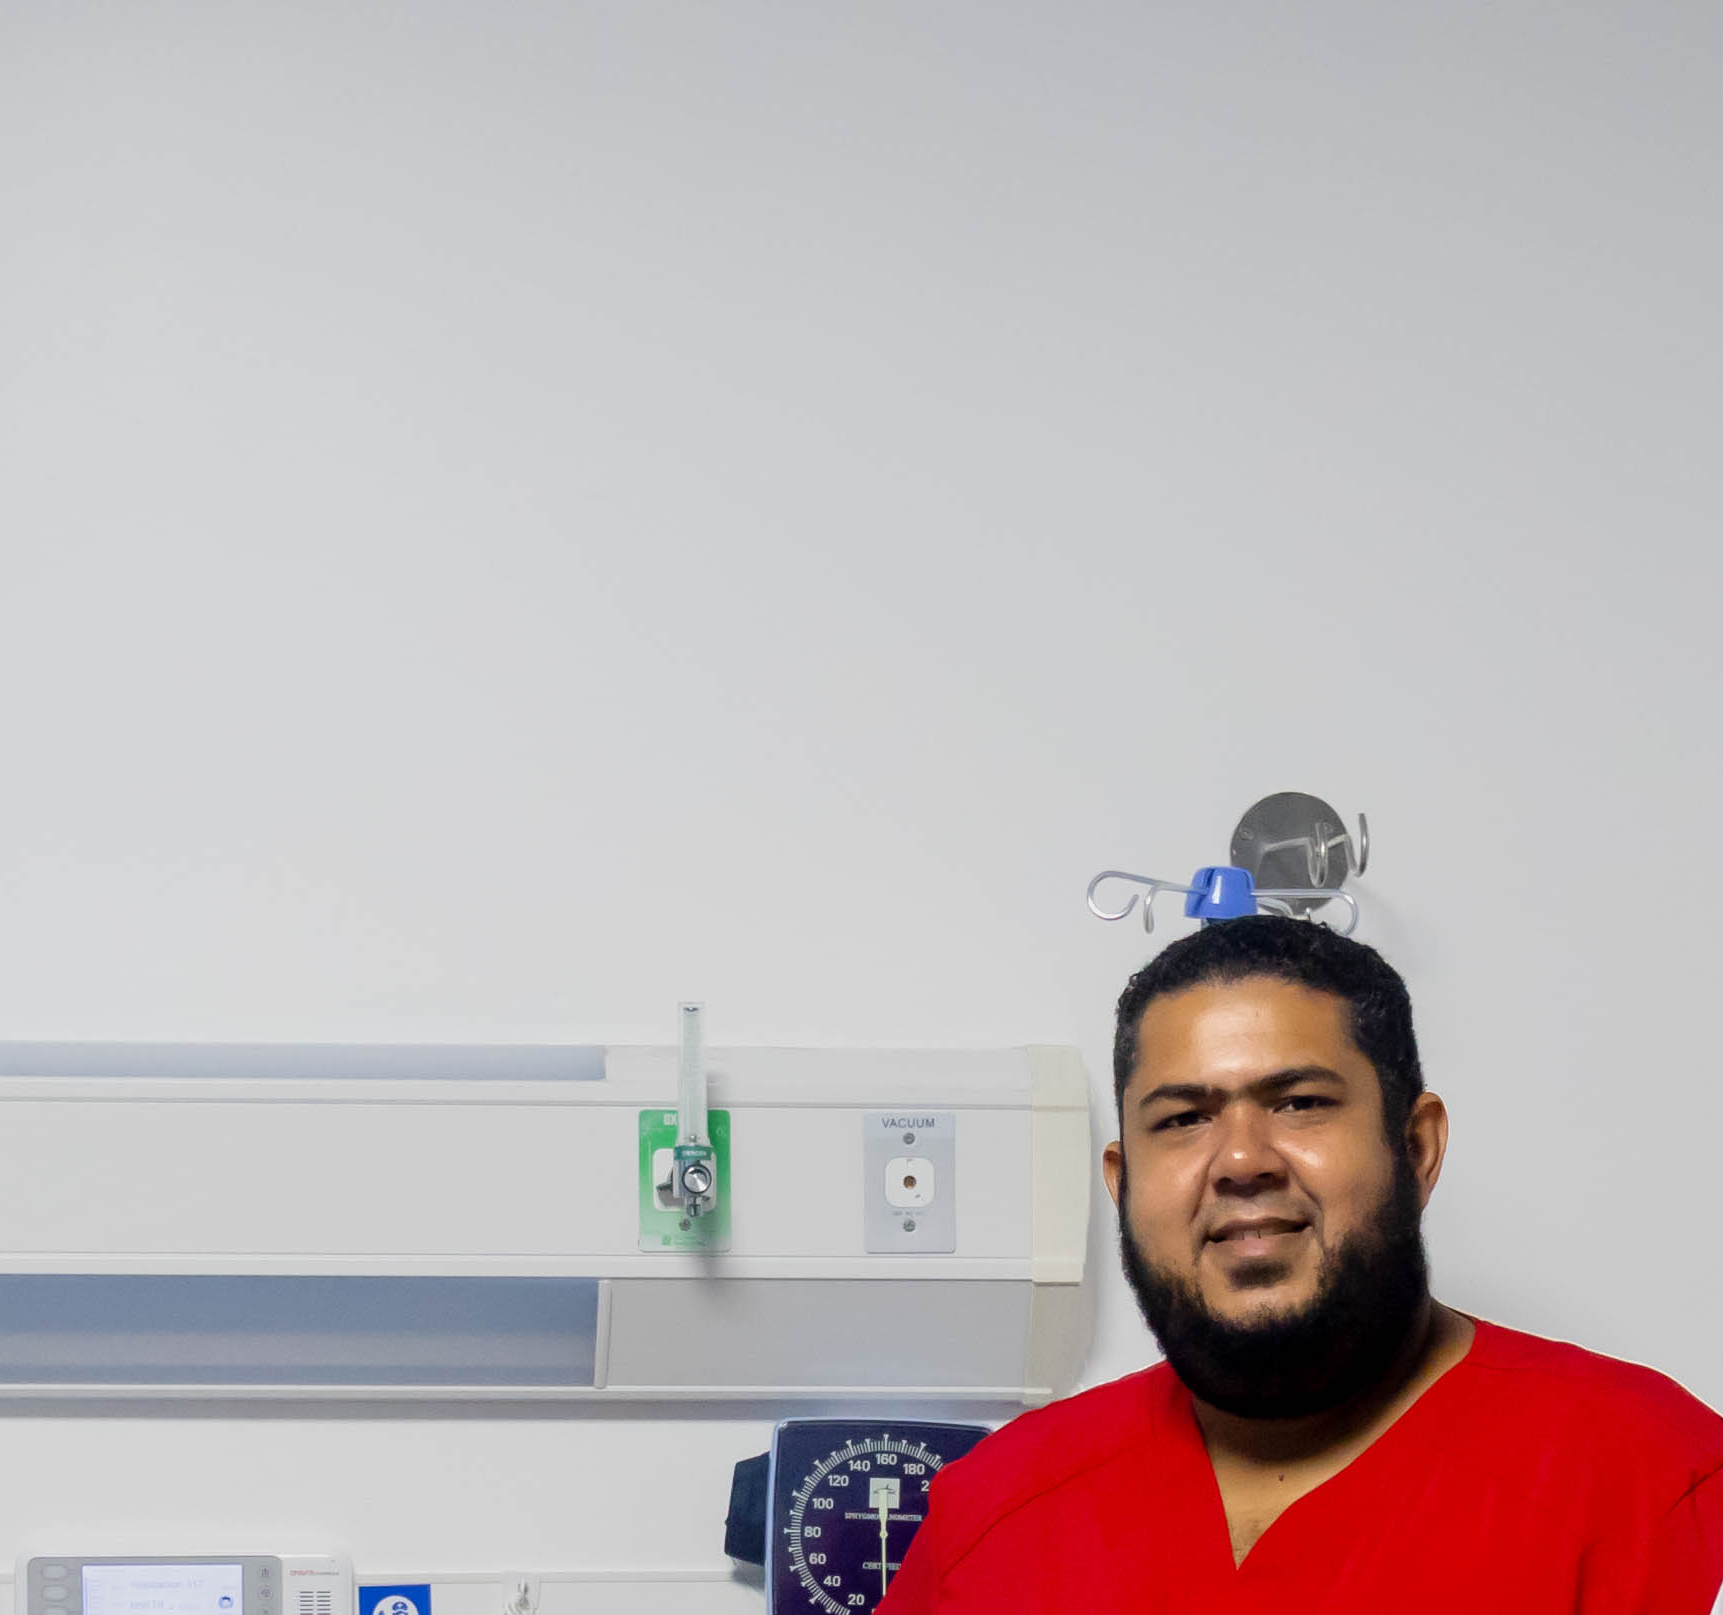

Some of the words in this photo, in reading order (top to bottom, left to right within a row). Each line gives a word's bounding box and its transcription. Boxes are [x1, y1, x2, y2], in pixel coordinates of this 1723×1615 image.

[882, 1118, 935, 1129] VACUUM
[848, 1459, 871, 1472] 140
[876, 1453, 898, 1466] 160
[903, 1463, 926, 1475] 180
[828, 1475, 849, 1487] 120
[812, 1498, 834, 1510] 100
[804, 1526, 822, 1538] 80
[808, 1553, 827, 1565] 60
[823, 1575, 841, 1587] 40
[847, 1594, 865, 1606] 20
